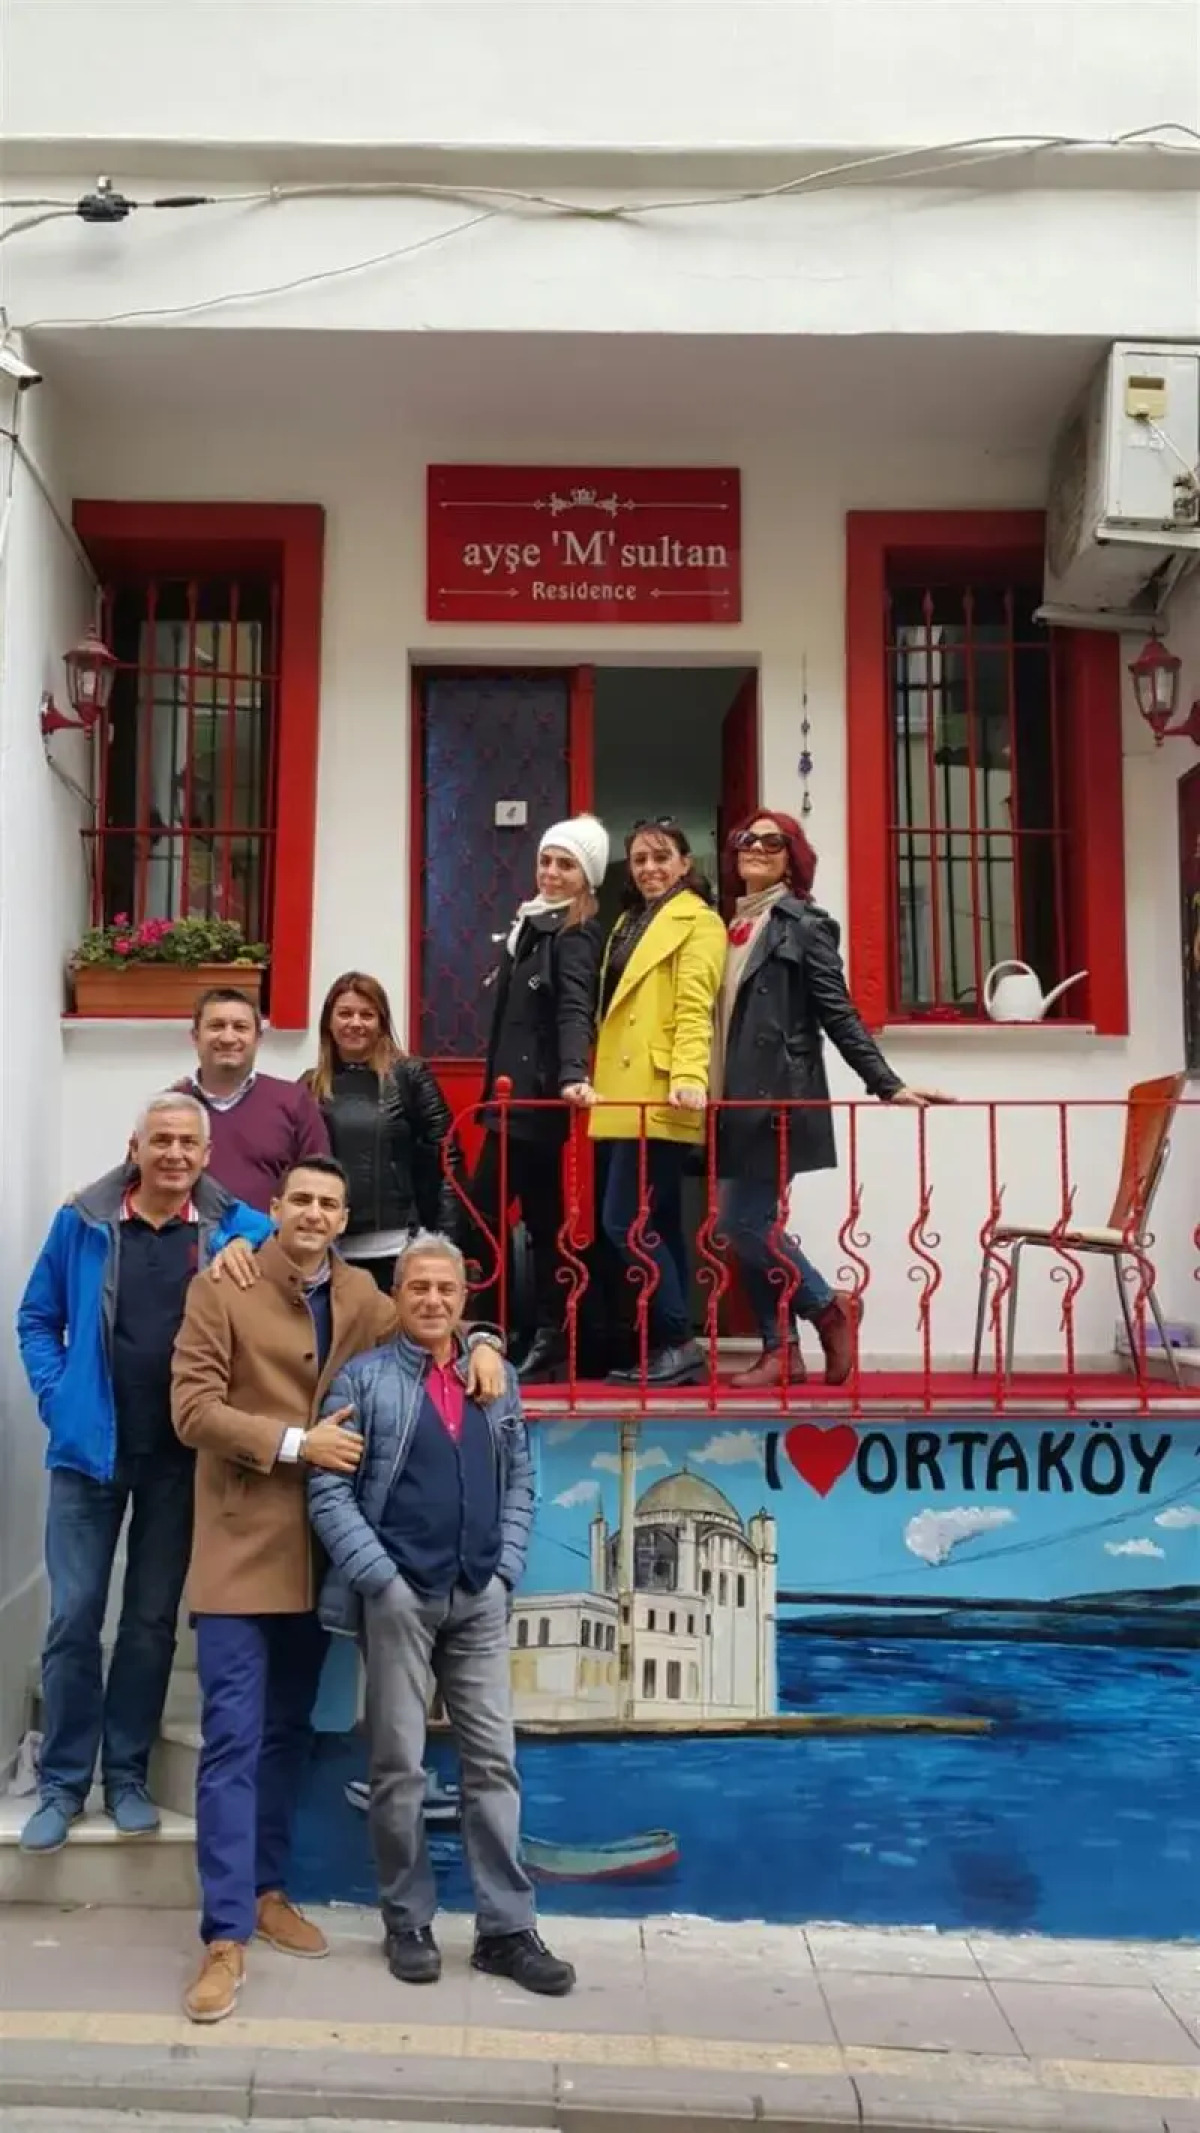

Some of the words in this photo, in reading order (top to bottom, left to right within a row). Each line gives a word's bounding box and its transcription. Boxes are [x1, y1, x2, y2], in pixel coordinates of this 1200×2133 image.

[462, 542, 541, 575] ayşe
[552, 530, 615, 567] 'M'
[620, 535, 728, 569] sultan
[532, 581, 637, 601] Residence
[764, 1431, 783, 1491] I
[856, 1419, 1173, 1496] ORTAKÖY
